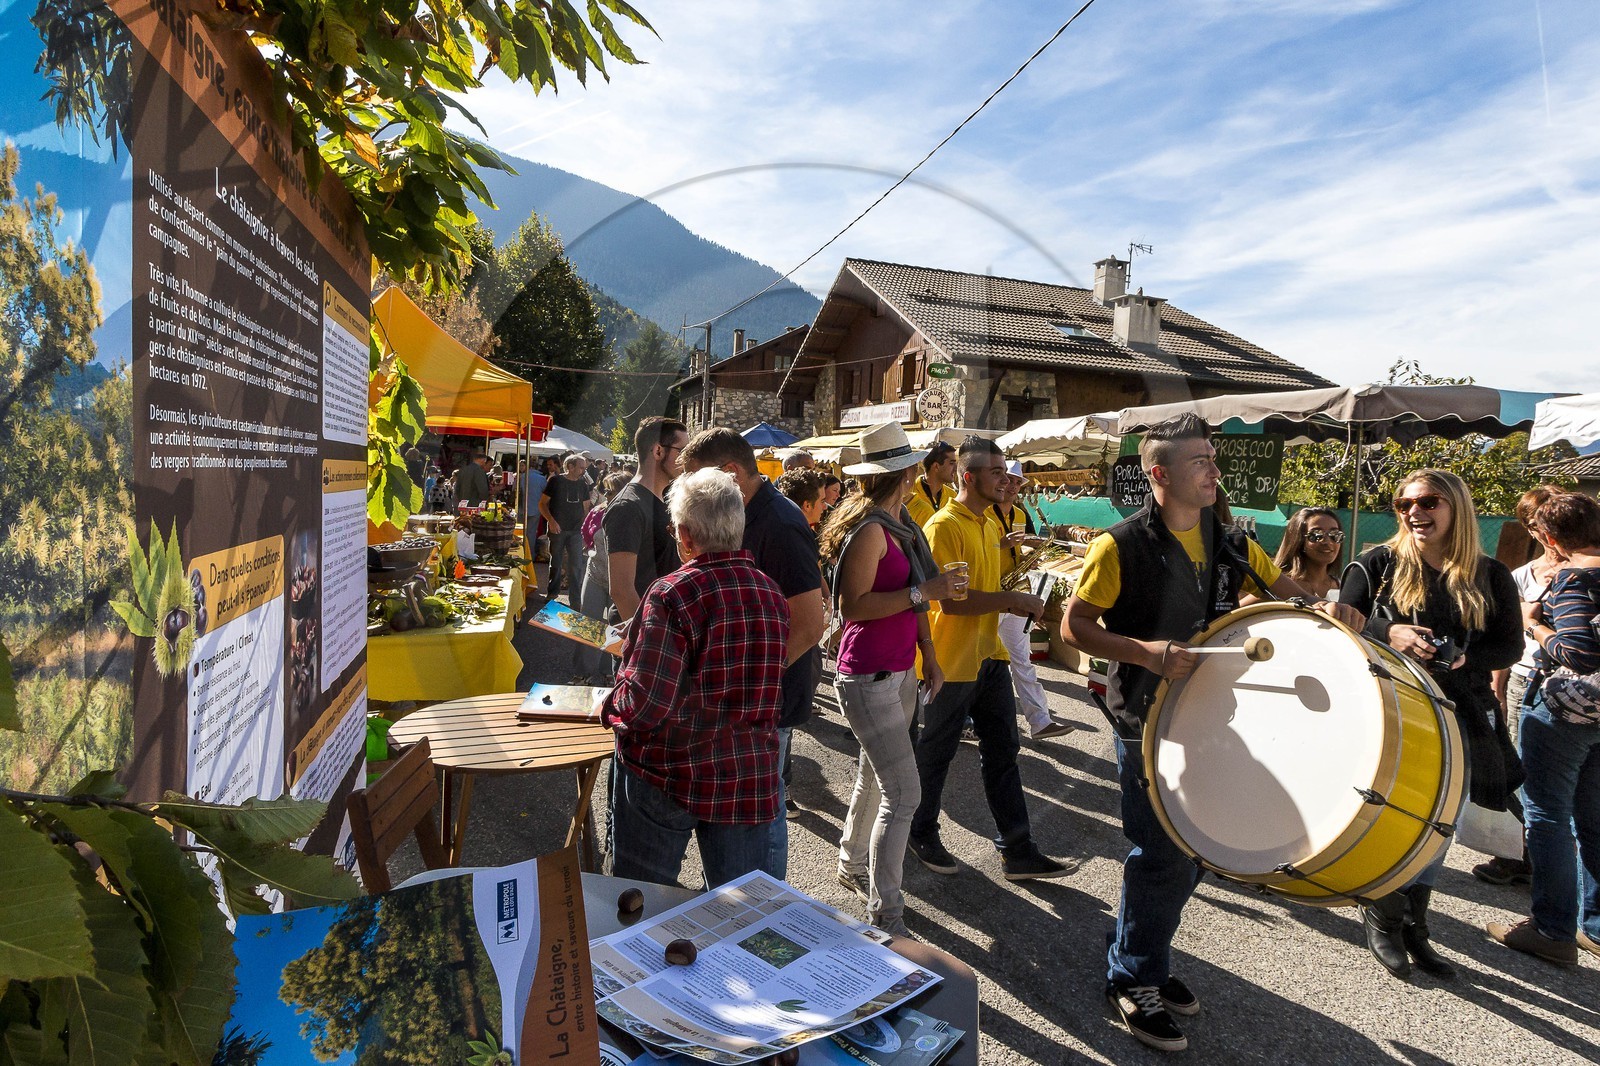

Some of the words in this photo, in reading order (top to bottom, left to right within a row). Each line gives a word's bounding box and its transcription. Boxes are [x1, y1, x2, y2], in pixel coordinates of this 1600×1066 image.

[149, 168, 172, 200] Utilisé
[174, 193, 183, 208] au
[184, 196, 204, 224] départ
[206, 218, 224, 240] comme
[226, 233, 232, 246] un
[233, 239, 249, 259] moyen
[250, 248, 255, 263] de
[149, 193, 158, 214] de
[161, 207, 205, 247] confectionner
[207, 236, 212, 252] le
[229, 251, 235, 268] du
[216, 166, 227, 205] Le
[230, 189, 268, 242] châtaignier
[271, 224, 275, 247] à
[276, 232, 294, 264] travers
[304, 257, 318, 286] siècles
[149, 224, 190, 258] campagnes.
[149, 263, 164, 285] Très
[166, 274, 180, 296] vite,
[182, 281, 208, 307] l'homme
[209, 299, 212, 309] a
[214, 301, 231, 318] cultivé
[232, 307, 236, 321] le
[237, 311, 261, 334] châtaignier
[262, 327, 270, 338] avec
[271, 328, 275, 340] le
[149, 287, 158, 306] de
[160, 292, 179, 315] fruits
[181, 306, 188, 318] et
[189, 306, 197, 323] de
[199, 310, 212, 329] bois.
[213, 317, 225, 335] Mais
[227, 324, 231, 338] la
[233, 329, 248, 345] culture
[249, 334, 255, 348] du
[256, 338, 277, 358] châtaignier
[149, 311, 153, 328] à
[156, 319, 176, 337] partir
[178, 323, 186, 341] du
[206, 336, 222, 354] siècle
[223, 345, 234, 358] avec
[235, 346, 251, 365] l'exode
[252, 356, 265, 370] massif
[150, 341, 165, 357] gers
[167, 341, 175, 359] de
[177, 346, 213, 371] châtaigniers
[215, 362, 221, 373] en
[222, 360, 238, 379] France
[246, 372, 260, 386] passée
[261, 373, 266, 387] de
[281, 380, 295, 396] hectares
[295, 389, 299, 398] en
[150, 360, 179, 383] hectares
[182, 373, 189, 385] en
[192, 371, 207, 390] 1972.
[920, 390, 948, 408] RESTAURANT
[922, 409, 946, 421] PIZZERIA
[150, 403, 187, 427] Désormais,
[189, 409, 197, 425] les
[199, 412, 232, 430] sylviculteurs
[232, 418, 238, 430] et
[238, 419, 271, 434] castanéiculteurs
[279, 427, 282, 436] un
[151, 433, 163, 444] une
[165, 430, 190, 446] activité
[193, 431, 238, 451] économiquement
[239, 436, 252, 450] viable
[253, 441, 258, 450] en
[259, 439, 274, 451] mettant
[275, 443, 279, 451] en
[1213, 438, 1274, 458] PROSECCO
[151, 453, 162, 468] des
[164, 458, 189, 473] vergers
[192, 454, 226, 468] traditionnels
[227, 459, 233, 468] ou
[244, 455, 269, 472] peuplements
[270, 455, 287, 468] forestiers.
[1255, 476, 1279, 496] DRY
[210, 564, 228, 588] Dans
[231, 555, 252, 584] quelles
[254, 546, 280, 570] conditions
[217, 590, 239, 620] peut-il
[241, 579, 270, 606] s'épanouir
[201, 646, 234, 673] Température
[239, 632, 253, 650] Climat
[201, 782, 211, 799] Eau
[562, 865, 572, 893] terroir
[564, 895, 573, 908] du
[568, 910, 577, 946] saveurs
[569, 948, 578, 959] et
[546, 940, 567, 1026] Châtaigne,
[570, 962, 582, 1002] histoire
[575, 1004, 585, 1032] entre
[549, 1032, 569, 1060] La
